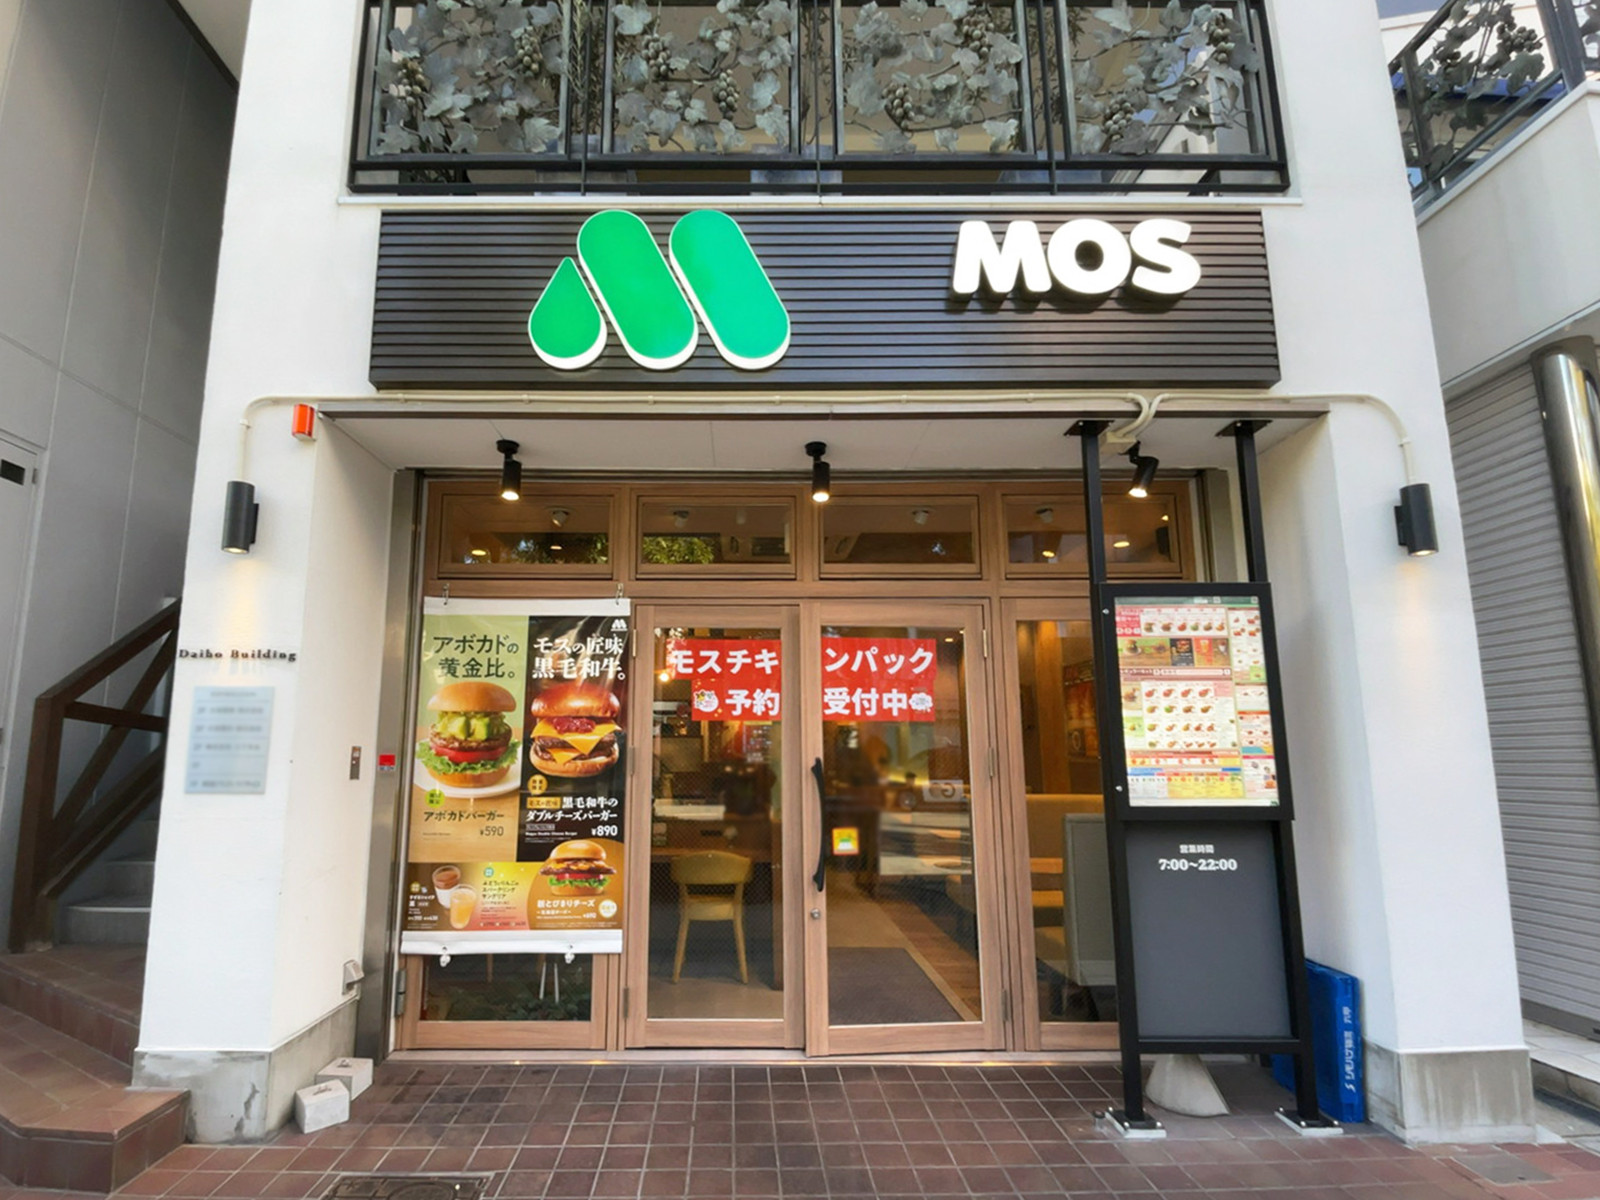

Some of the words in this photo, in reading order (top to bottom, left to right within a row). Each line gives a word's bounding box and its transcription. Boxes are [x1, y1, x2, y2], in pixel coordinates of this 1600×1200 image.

[952, 218, 1202, 296] MOS
[432, 634, 519, 656] アボカドの
[533, 635, 624, 656] モスの匠味
[230, 649, 297, 663] Building
[673, 648, 779, 675] モスチキ
[824, 646, 934, 674] ンパック
[438, 657, 516, 679] 黄金比。
[532, 657, 626, 680] 黒毛和牛。
[725, 689, 780, 716] 予約
[823, 687, 908, 716] 受付中
[562, 796, 619, 809] 黒毛和牛の
[423, 811, 505, 822] アボカドバーガー
[526, 810, 618, 822] ダブルチーズバーガー
[480, 825, 504, 837] ¥590
[591, 825, 618, 837] ¥890
